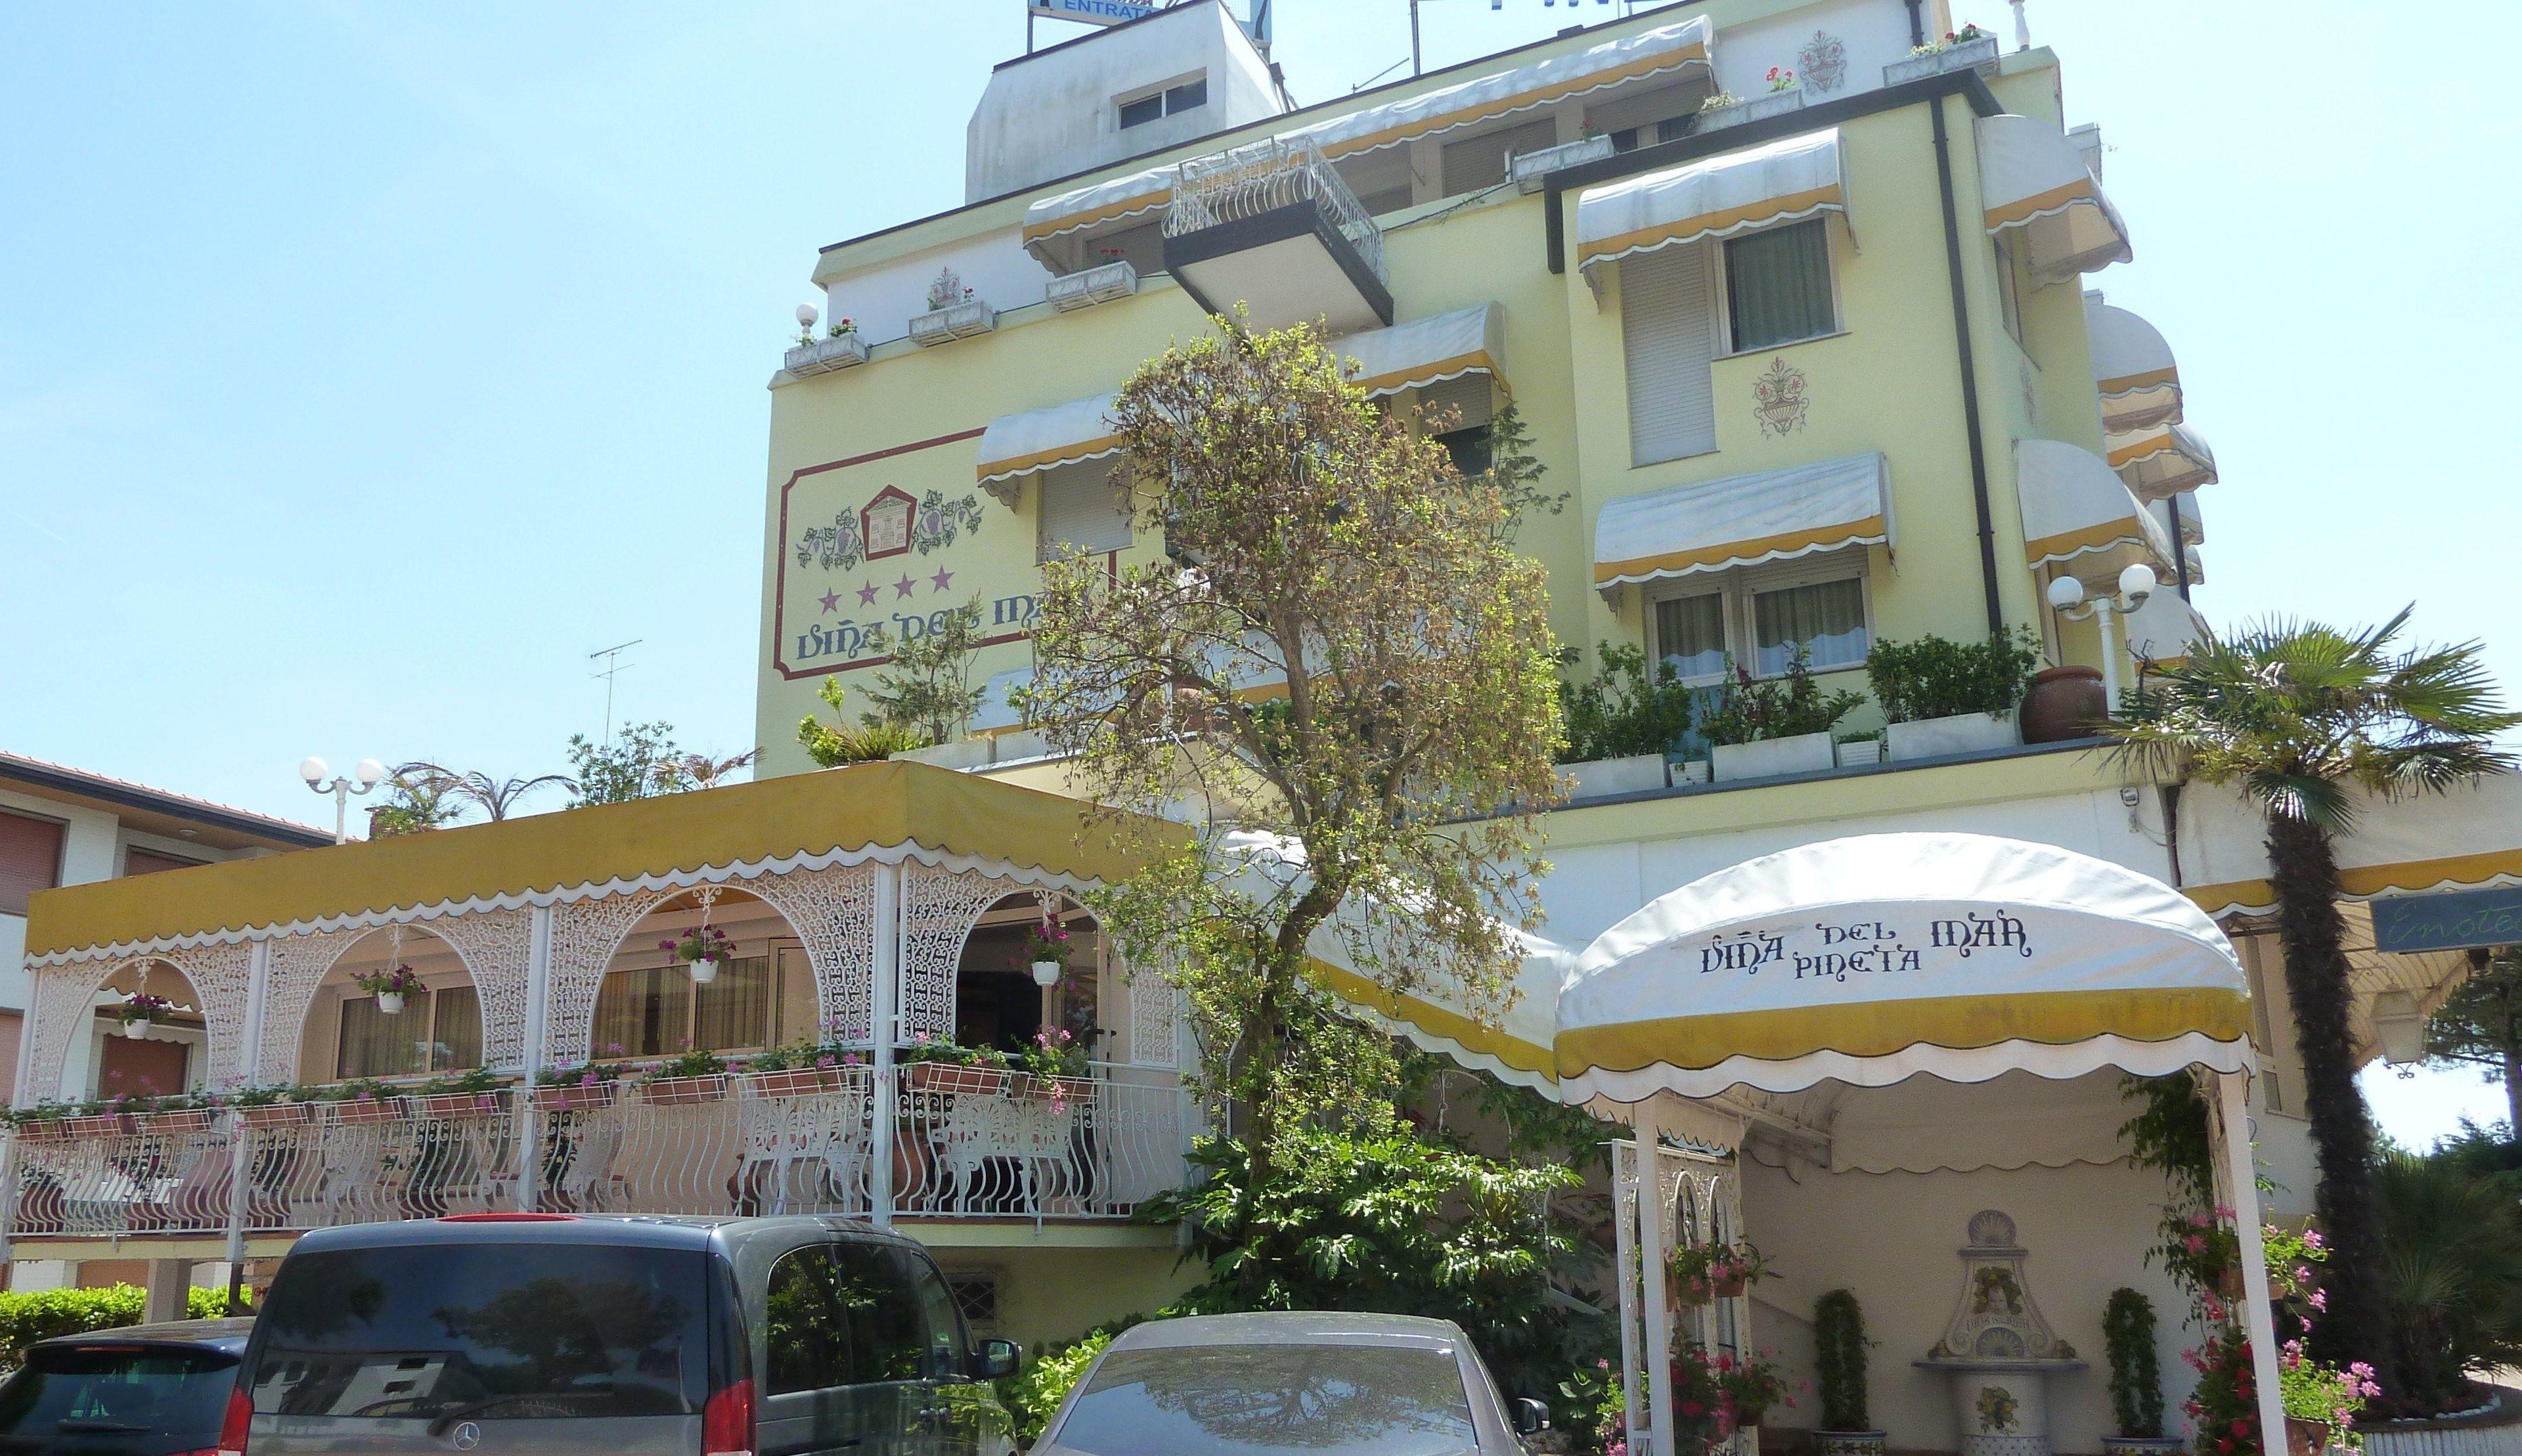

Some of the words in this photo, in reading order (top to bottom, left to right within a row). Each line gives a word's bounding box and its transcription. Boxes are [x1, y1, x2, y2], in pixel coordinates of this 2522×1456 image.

[1700, 930, 1784, 975] VIÑA
[1815, 922, 1896, 945] DEL
[1931, 909, 2032, 958] MAR
[1794, 944, 1921, 982] PINETA
